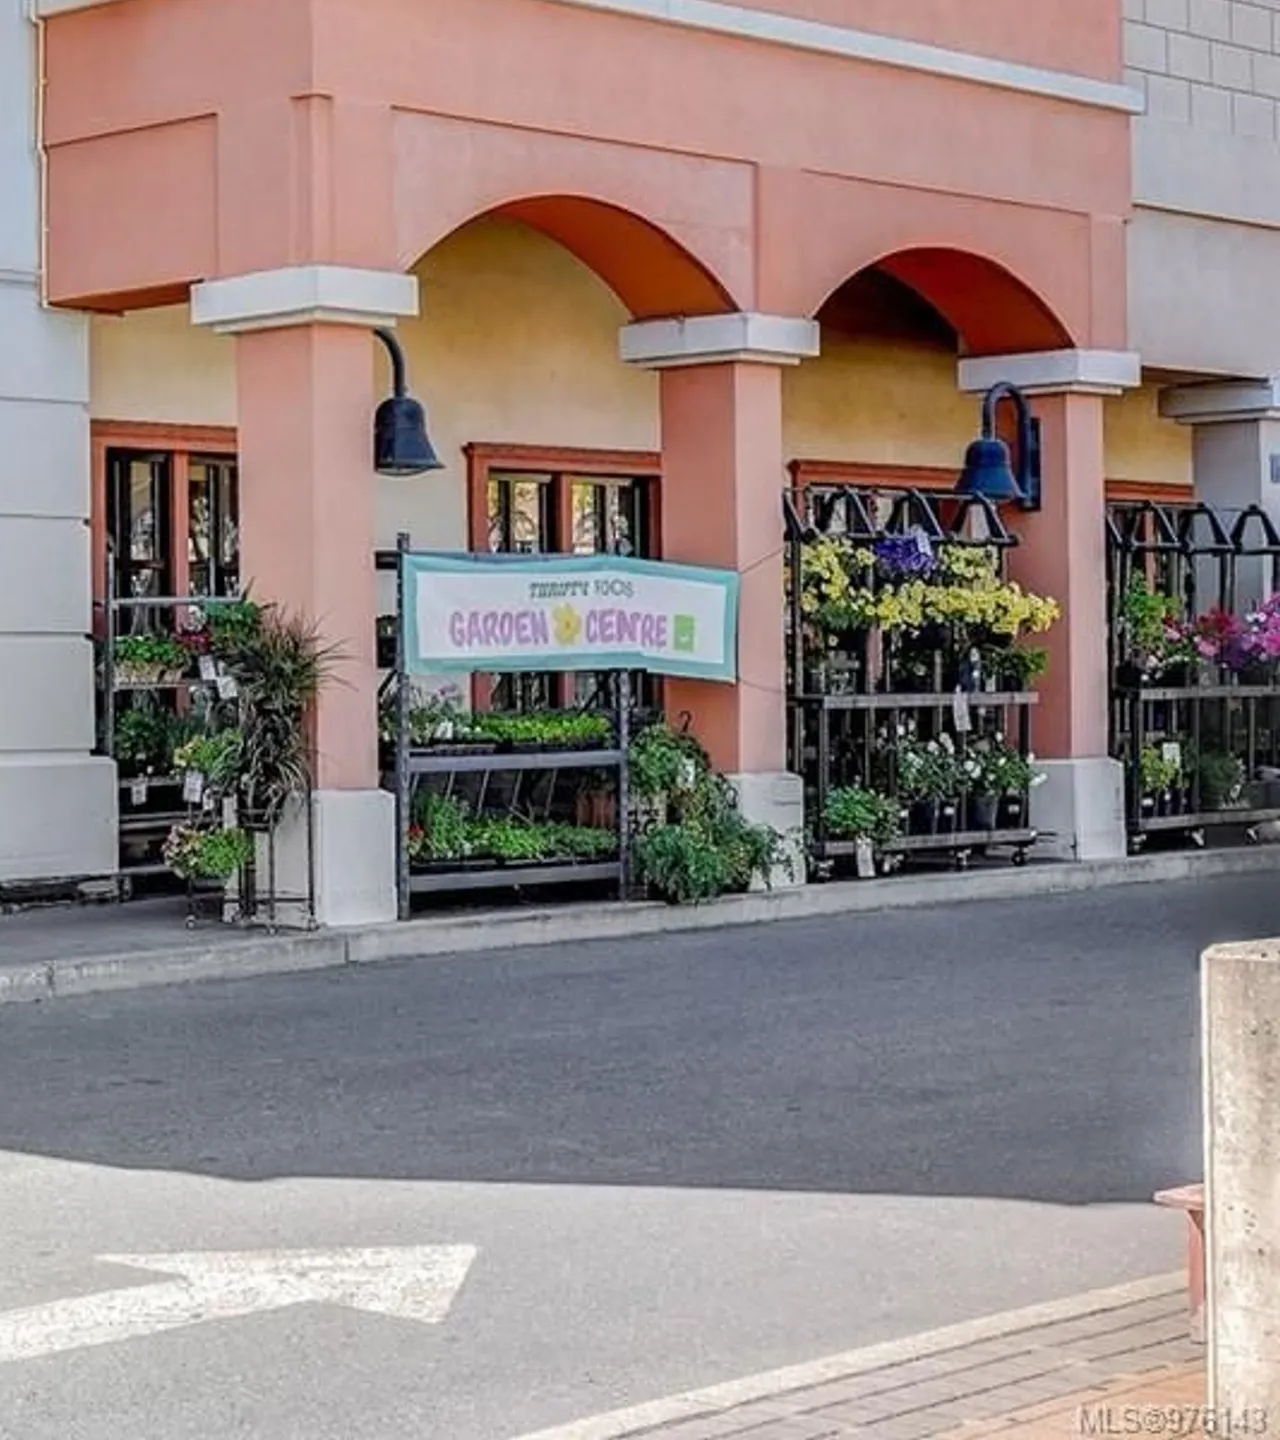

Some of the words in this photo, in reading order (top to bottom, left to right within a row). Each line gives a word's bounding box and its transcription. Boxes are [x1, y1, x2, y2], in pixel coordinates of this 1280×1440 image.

[529, 580, 590, 598] THRIFTY
[449, 610, 549, 648] GARDEN
[585, 608, 668, 648] CENTRE
